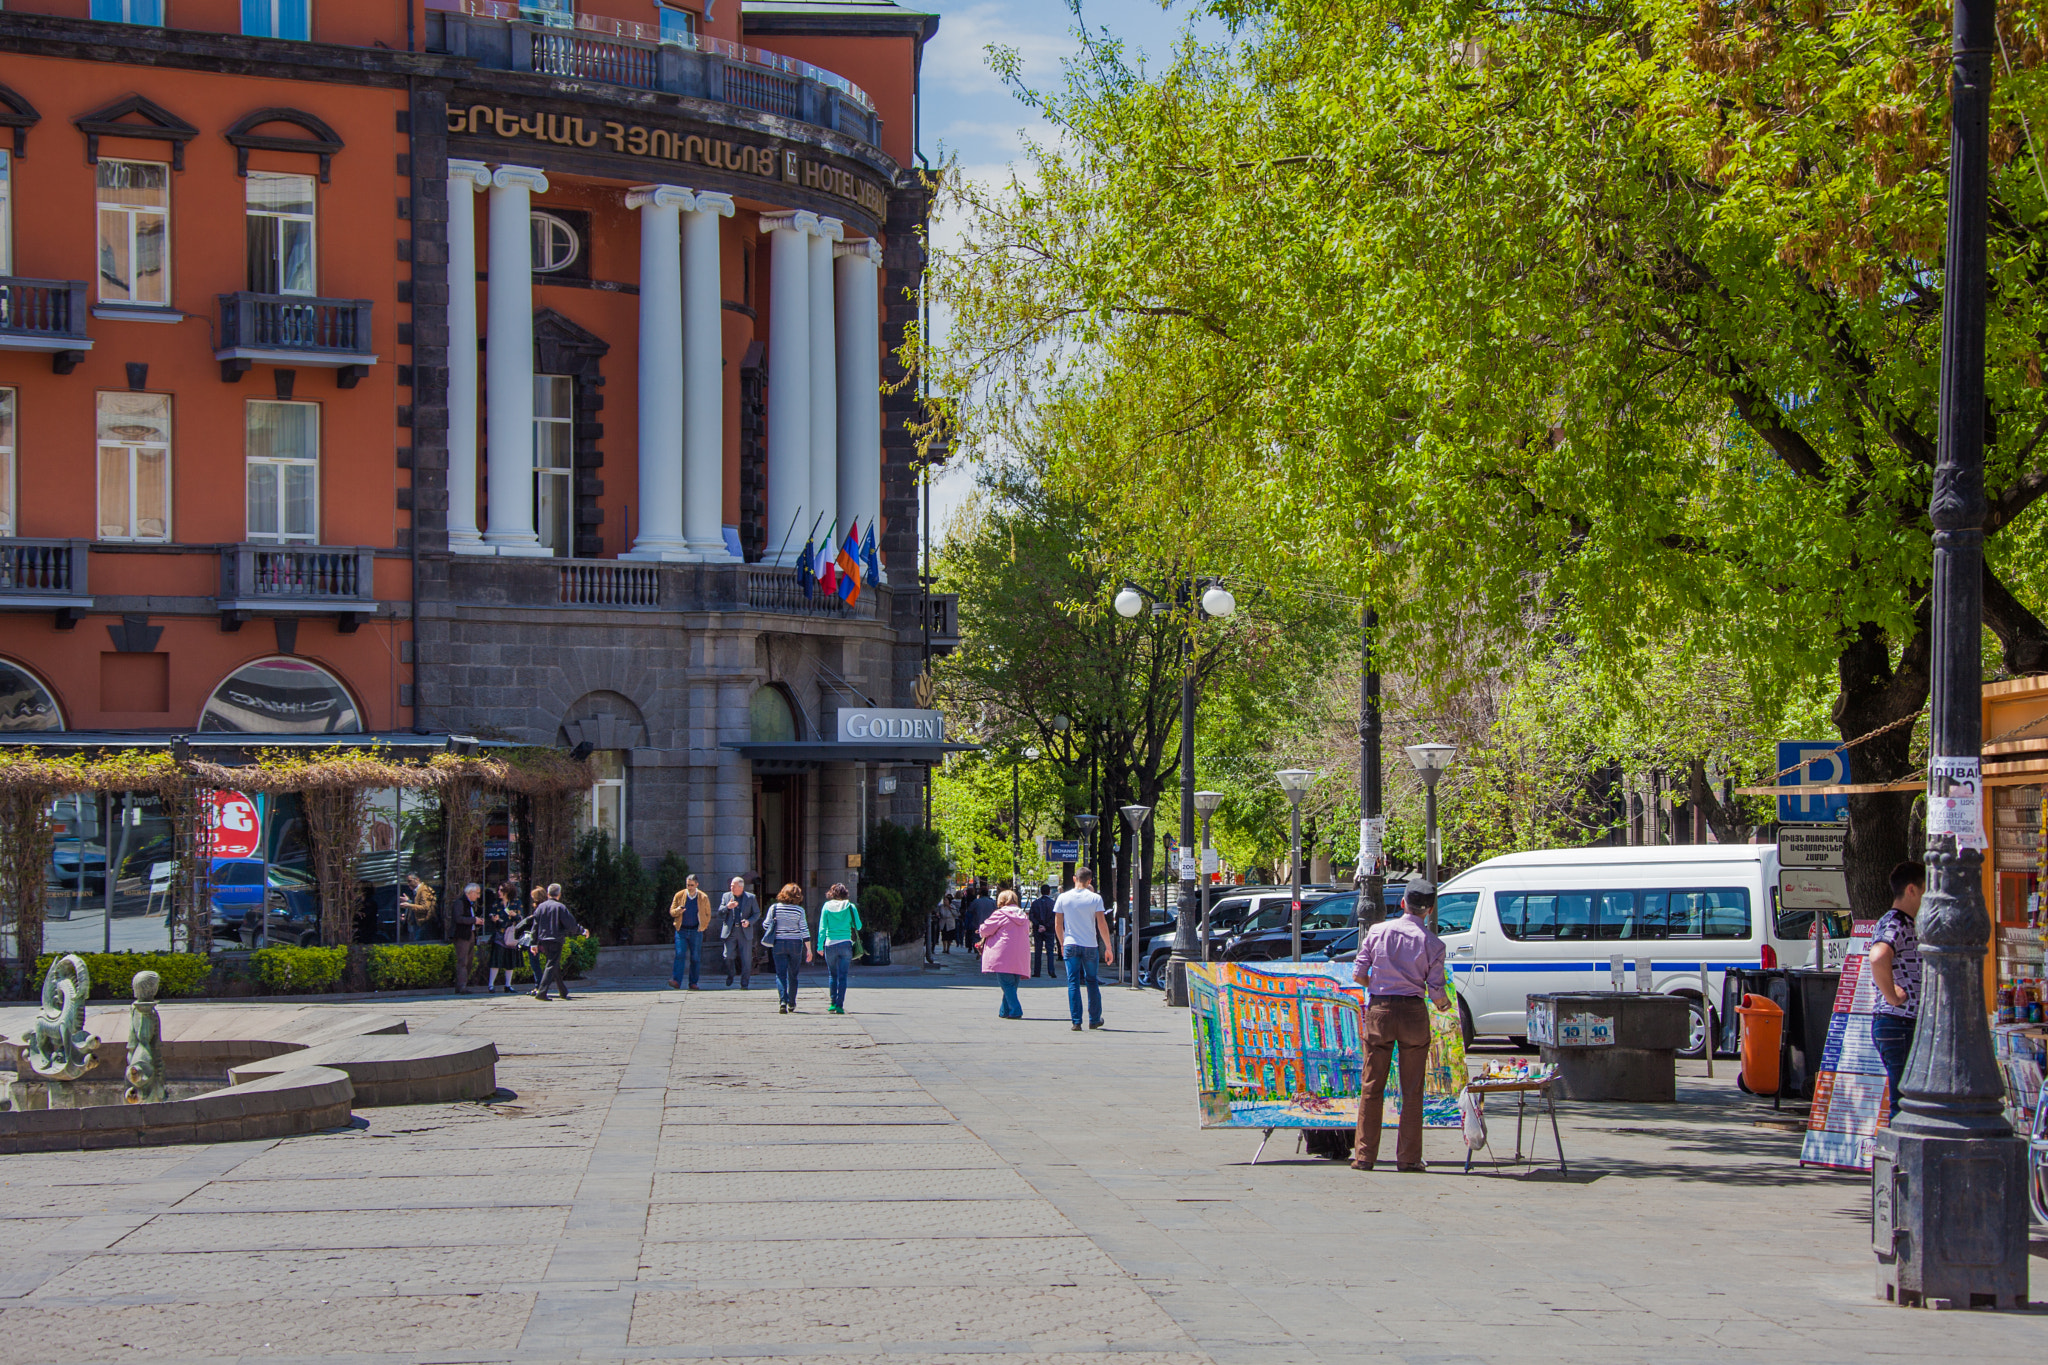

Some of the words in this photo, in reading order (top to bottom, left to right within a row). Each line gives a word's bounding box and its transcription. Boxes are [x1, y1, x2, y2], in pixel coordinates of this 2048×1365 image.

[803, 160, 858, 200] HOTEL
[846, 713, 934, 739] GOLDEN
[1800, 749, 1843, 812] P
[1591, 1025, 1608, 1037] 10
